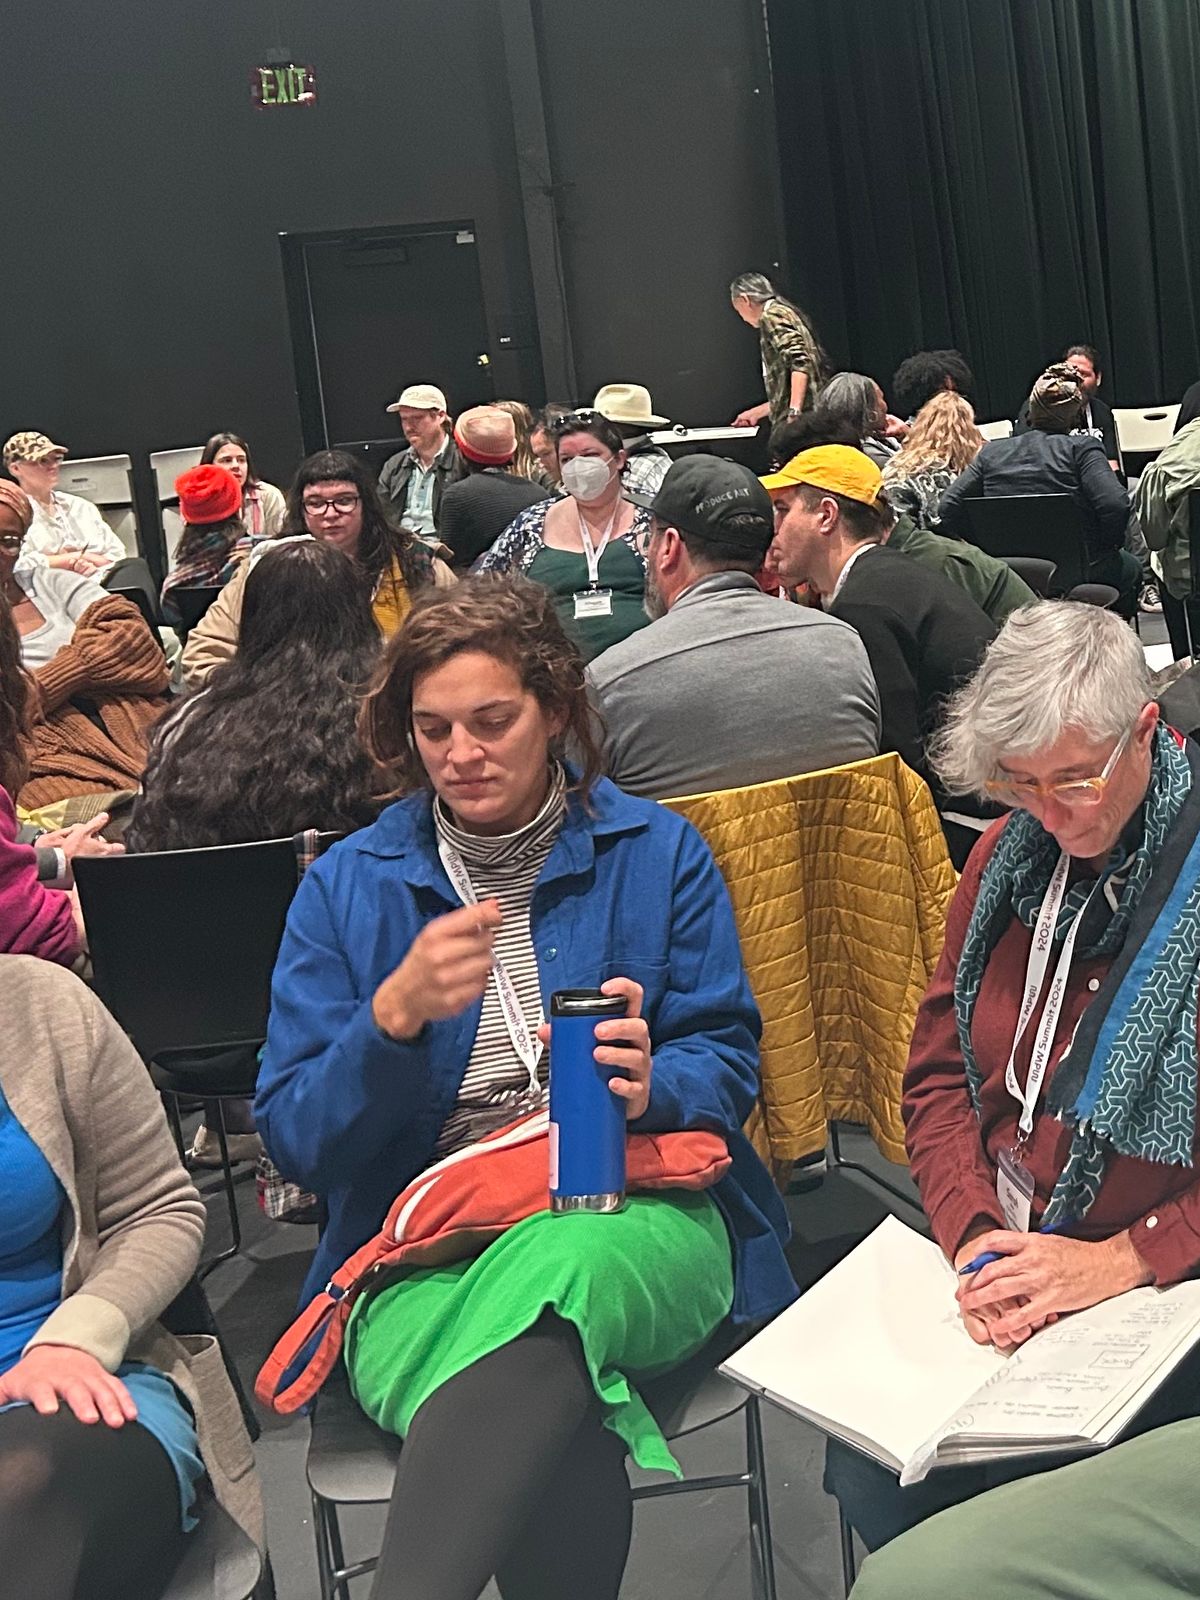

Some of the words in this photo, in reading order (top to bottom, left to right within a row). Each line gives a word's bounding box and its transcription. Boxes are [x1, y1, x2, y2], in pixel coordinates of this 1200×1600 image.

[260, 67, 306, 103] EXIT
[455, 878, 474, 905] Summ
[1043, 883, 1061, 921] Summit
[1036, 921, 1051, 953] 2024
[502, 991, 520, 1026] Summit
[514, 1027, 529, 1054] 2024
[1039, 1009, 1055, 1051] Summit
[1049, 978, 1063, 1008] 2024
